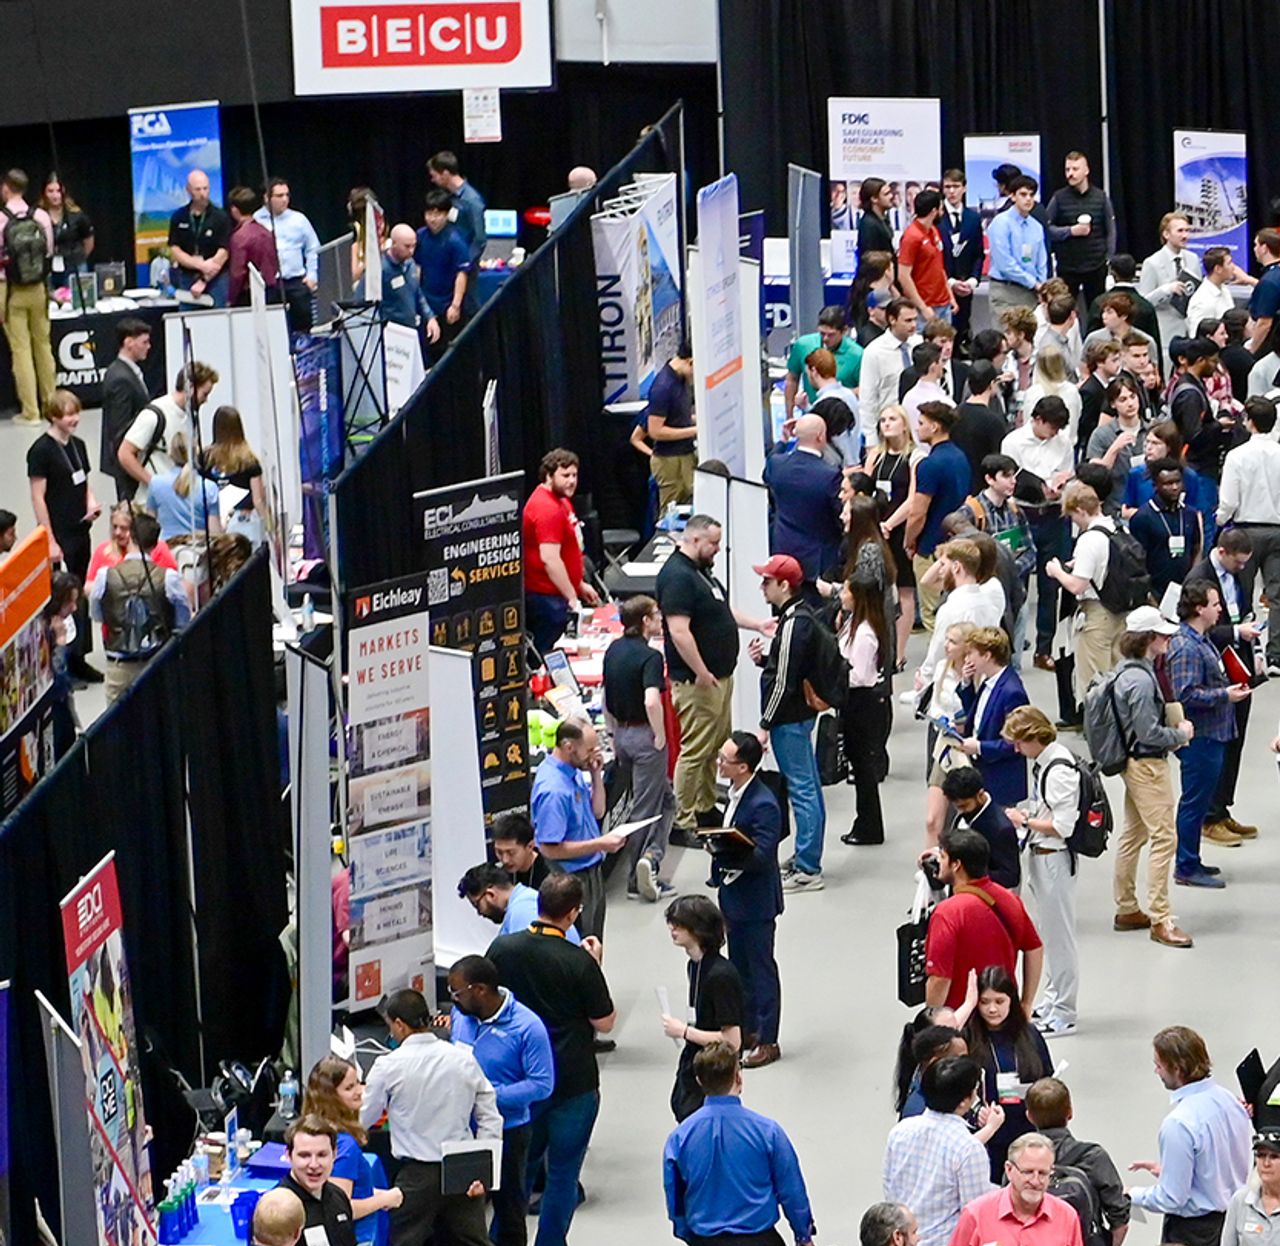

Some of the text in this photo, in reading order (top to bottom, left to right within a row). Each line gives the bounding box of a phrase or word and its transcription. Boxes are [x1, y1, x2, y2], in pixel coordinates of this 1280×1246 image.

[131, 112, 172, 137] FCA
[842, 113, 870, 125] FDIC
[842, 129, 904, 138] SAFEGUARDING
[842, 137, 885, 146] AMERICA'S
[842, 146, 885, 154] ECONOMIC
[842, 154, 872, 162] FUTURE
[424, 505, 453, 529] ECI
[424, 520, 462, 541] ELECTRICAL
[444, 531, 520, 560] ENGINEERING
[478, 547, 521, 567] DESIGN
[469, 560, 521, 584] SERVICES
[372, 585, 423, 612] Eichleay
[359, 628, 420, 658] MARKETS
[357, 654, 422, 685] WE SERVE
[378, 729, 403, 742] ENERGY
[377, 744, 409, 758] CHEMICAL
[370, 784, 411, 802] SUSTAINABLE
[378, 803, 404, 815] ENERGY
[385, 847, 398, 858] LIFE
[376, 862, 407, 876] SCIENCES
[382, 916, 408, 929] METALS
